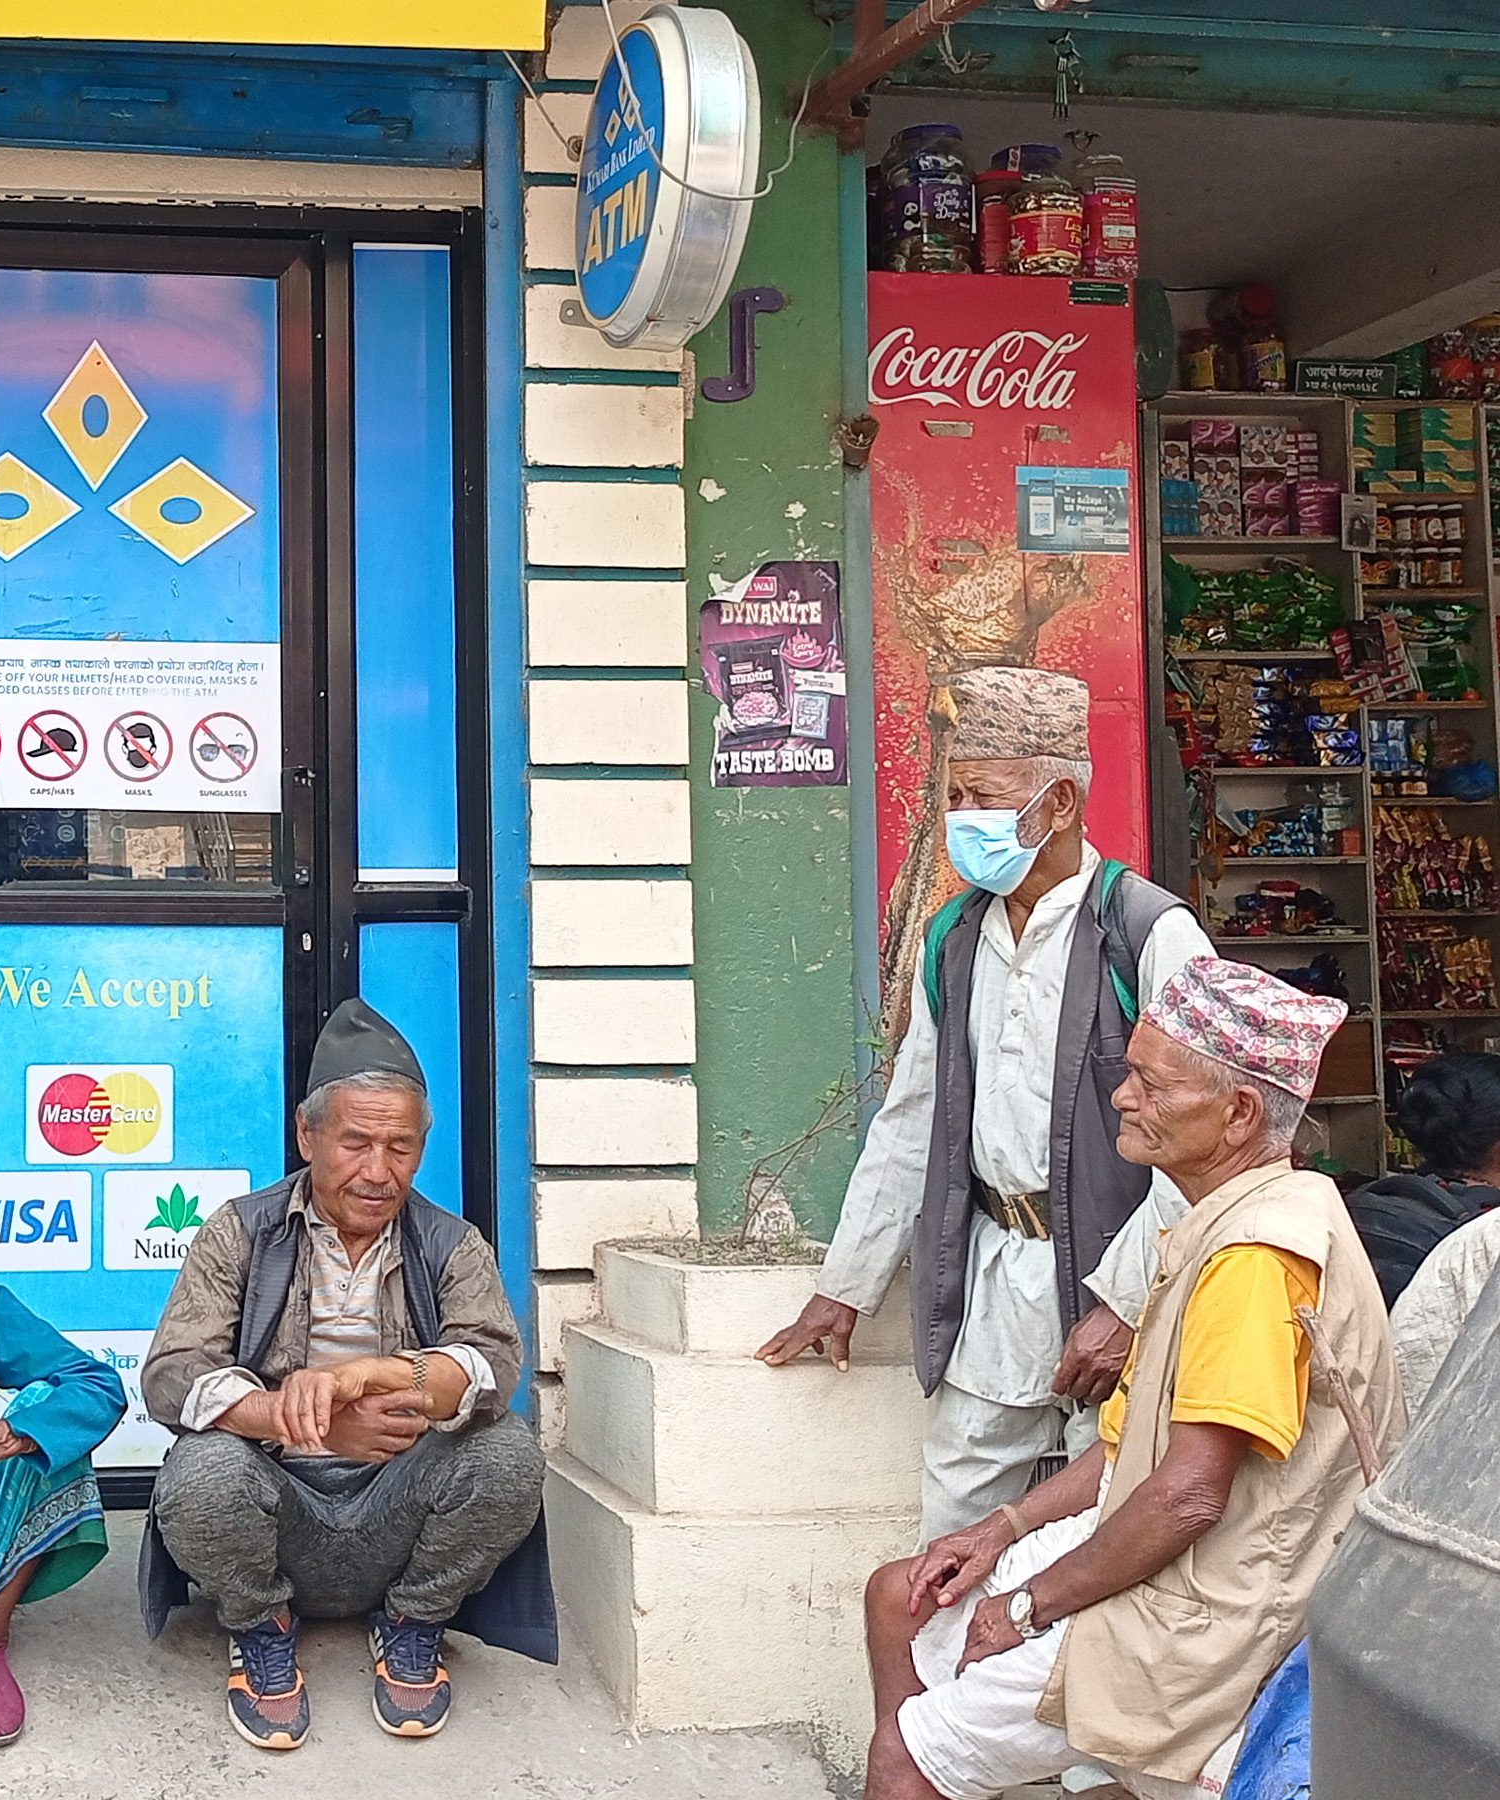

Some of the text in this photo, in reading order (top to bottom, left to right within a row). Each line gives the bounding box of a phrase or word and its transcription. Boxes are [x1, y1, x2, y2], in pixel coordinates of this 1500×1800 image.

[582, 168, 648, 276] ATM
[868, 327, 1089, 410] Coca-Cola
[720, 600, 822, 626] DYNAMITE
[5, 672, 26, 682] OFF
[29, 673, 58, 683] YOUR
[61, 673, 144, 685] HELMETS/HEAD
[147, 675, 207, 686] COVERING,
[209, 676, 247, 685] MASKS
[250, 676, 258, 685] &
[22, 685, 70, 696] GLASSES
[73, 686, 113, 696] BEFORE
[116, 687, 168, 697] ENTERING
[171, 687, 191, 697] THE
[194, 687, 218, 697] ATM
[715, 748, 835, 775] TASTE BOMB
[30, 787, 75, 796] CAPS/HATS
[62, 967, 214, 1020] Accept
[42, 1102, 157, 1125] MasterCard
[134, 1238, 190, 1260] Natio
